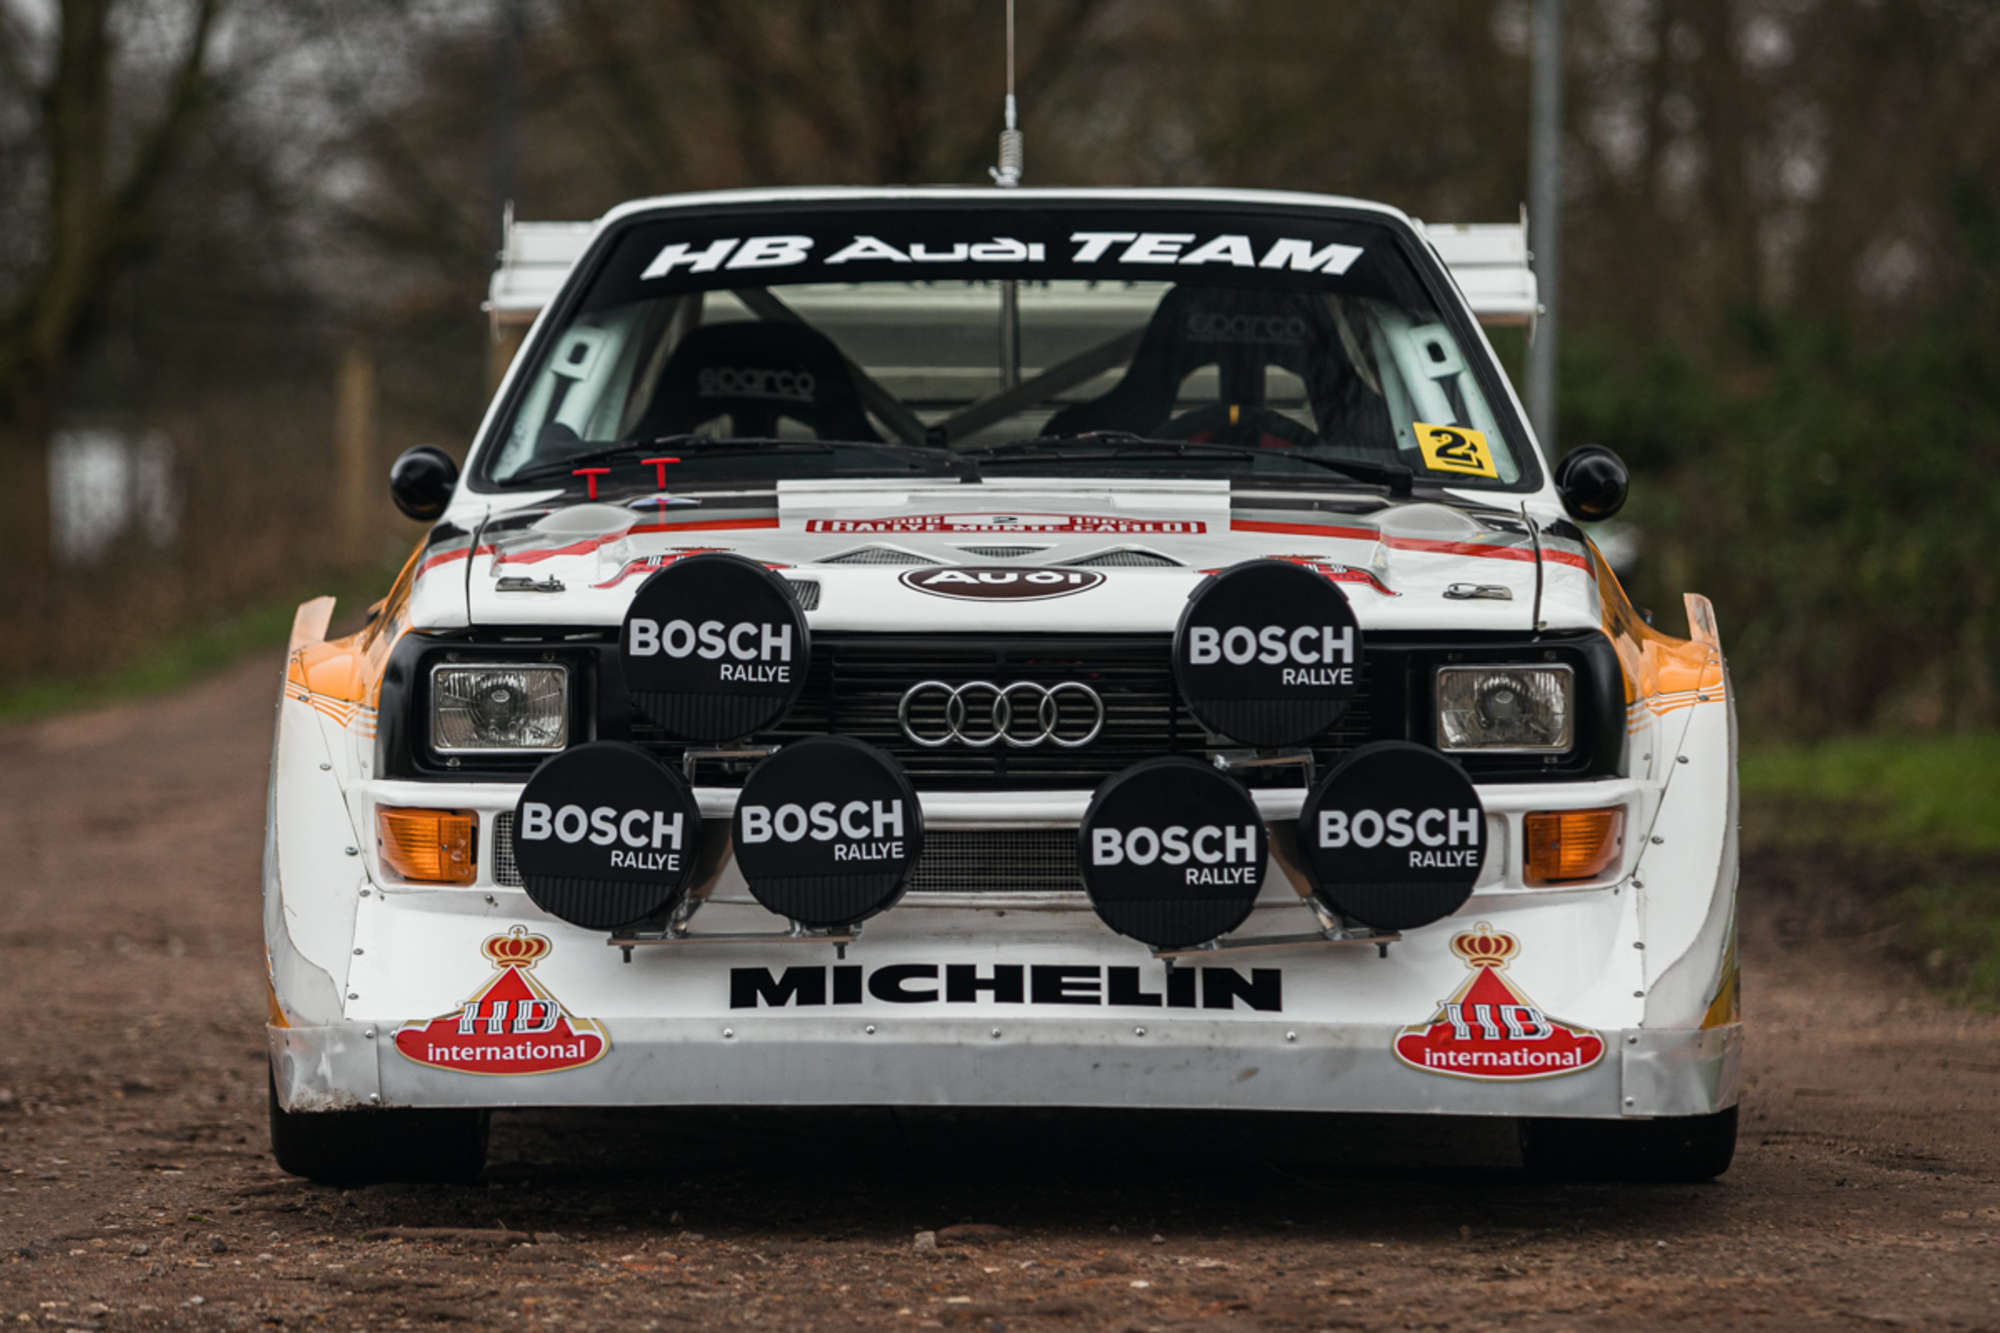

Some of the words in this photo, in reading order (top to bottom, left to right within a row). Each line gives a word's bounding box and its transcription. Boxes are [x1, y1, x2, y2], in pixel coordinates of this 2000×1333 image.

[641, 235, 814, 279] HB
[1070, 232, 1364, 275] TEAM
[831, 520, 942, 533] RALLYE
[629, 618, 792, 662] BOSCH
[1189, 625, 1353, 666] BOSCH
[720, 663, 791, 683] RALLYE
[1282, 667, 1353, 686] RALLYE
[521, 802, 684, 849] BOSCH
[741, 799, 903, 843] BOSCH
[1319, 808, 1478, 849] BOSCH
[834, 842, 904, 861] RALLYE
[1092, 825, 1256, 866] BOSCH
[610, 850, 680, 871] RALLYE
[1409, 850, 1478, 868] RALLYE
[1185, 868, 1256, 885] RALLYE
[730, 963, 1282, 1012] MICHELIN
[427, 1040, 585, 1062] international
[1424, 1048, 1582, 1067] international
